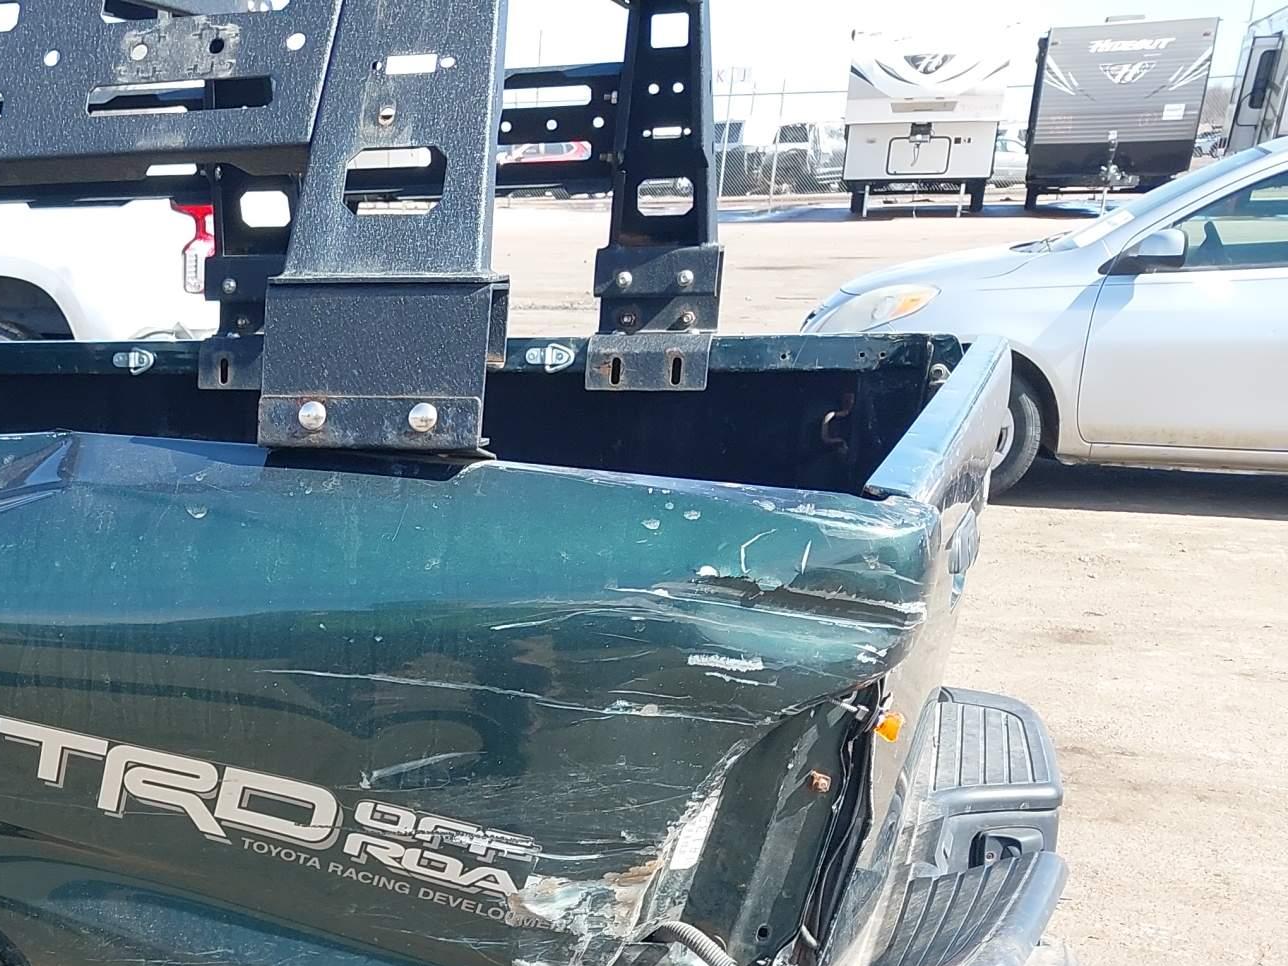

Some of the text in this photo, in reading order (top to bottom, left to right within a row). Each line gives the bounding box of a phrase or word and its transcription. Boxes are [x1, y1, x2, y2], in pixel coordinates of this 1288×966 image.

[241, 837, 321, 870] TOYOTA
[327, 862, 411, 895] RACING
[343, 832, 539, 898] ROA
